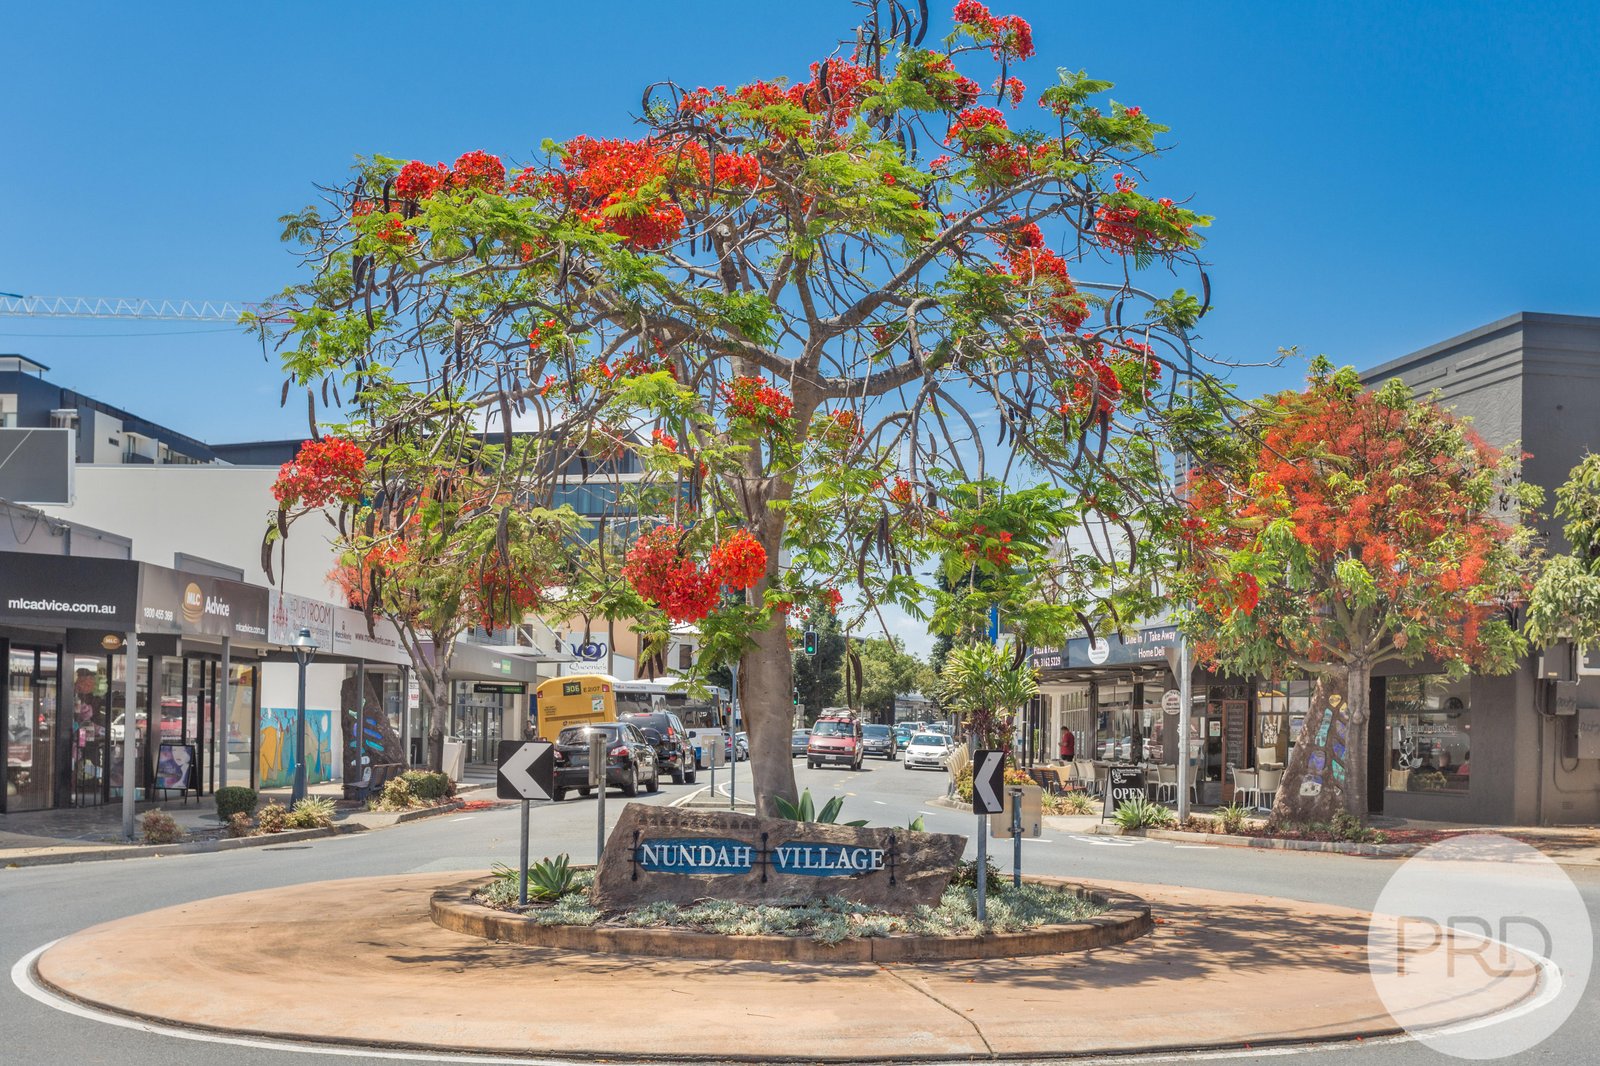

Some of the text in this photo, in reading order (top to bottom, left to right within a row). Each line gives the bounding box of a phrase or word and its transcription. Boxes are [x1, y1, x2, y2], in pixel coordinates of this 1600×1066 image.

[8, 598, 116, 614] mlcadvice.com.au
[187, 592, 229, 616] MLC Advice
[122, 639, 145, 647] Aice
[1125, 635, 1137, 644] Dine
[1137, 634, 1143, 643] In
[1148, 631, 1160, 642] Take
[1161, 630, 1176, 642] Away
[1138, 648, 1153, 658] Home
[565, 685, 580, 694] 306
[1112, 787, 1145, 800] OPEN
[640, 844, 886, 871] NUNDAH VILLAGE
